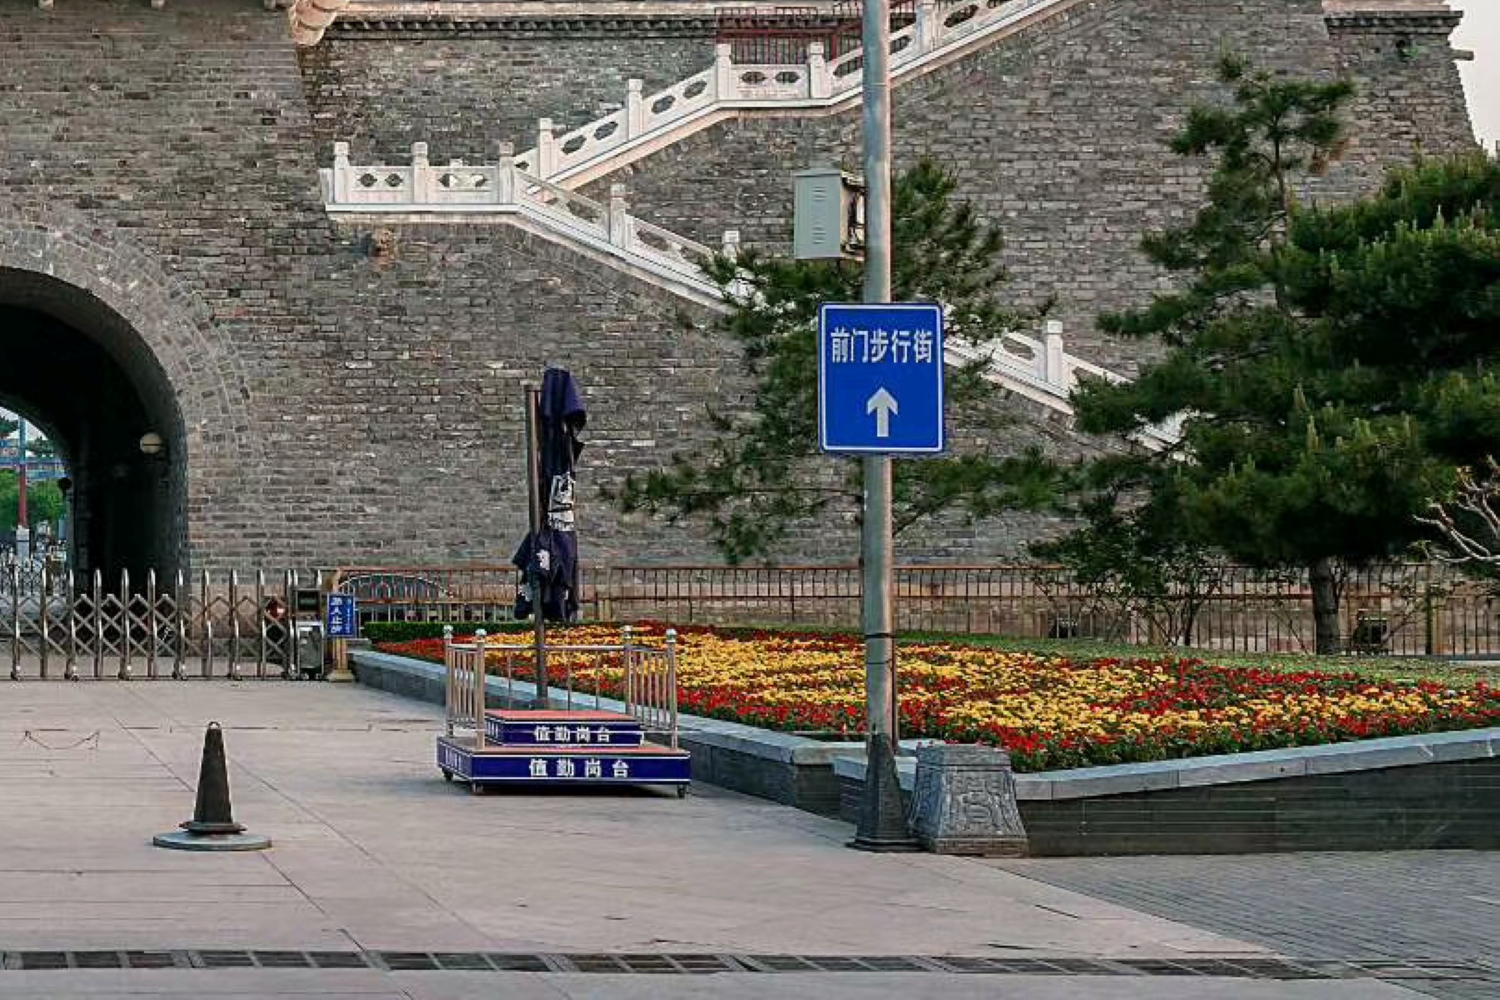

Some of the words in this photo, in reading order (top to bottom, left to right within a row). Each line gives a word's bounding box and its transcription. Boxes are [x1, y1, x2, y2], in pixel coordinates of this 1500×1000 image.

[830, 326, 933, 364] 前门步行街
[533, 725, 612, 743] 值勤岗台
[529, 758, 630, 778] 值勤岗台
